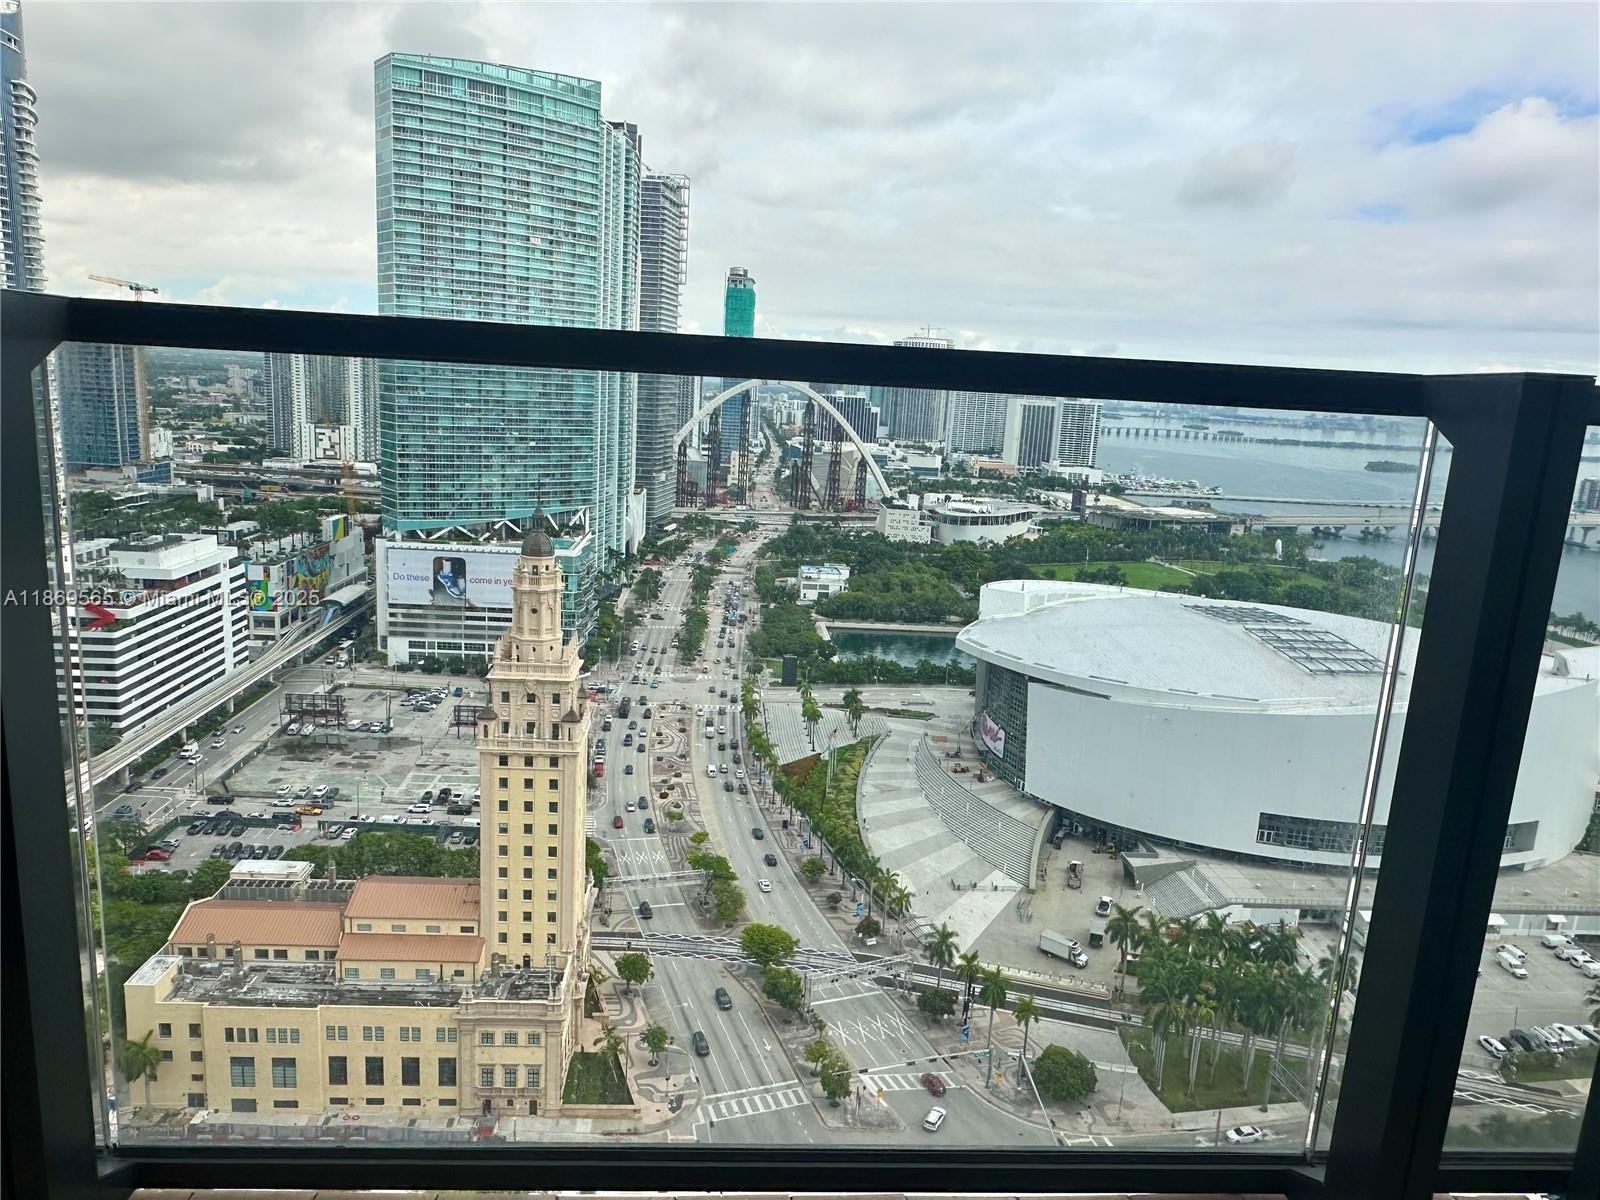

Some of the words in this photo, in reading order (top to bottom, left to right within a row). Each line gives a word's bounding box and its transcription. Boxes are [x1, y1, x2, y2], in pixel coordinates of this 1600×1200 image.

[393, 572, 405, 581] Do
[406, 573, 430, 582] these
[469, 577, 493, 585] come
[494, 577, 502, 585] in
